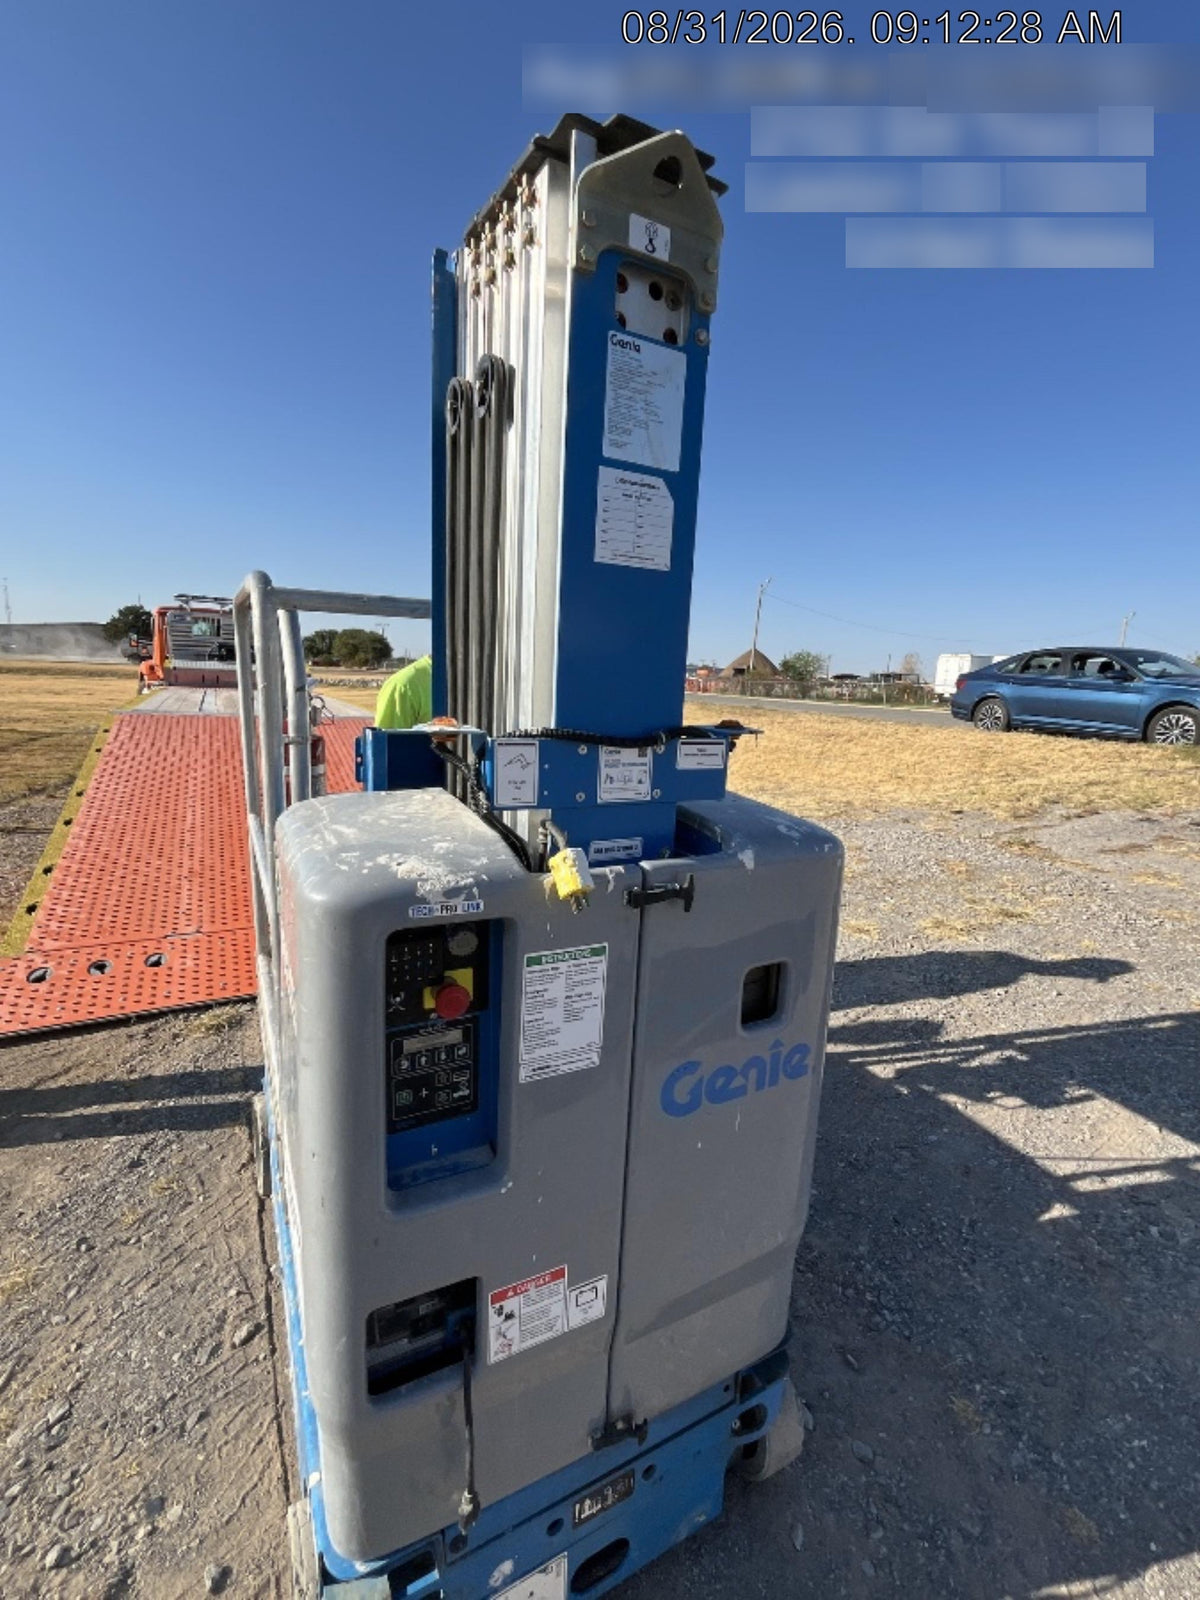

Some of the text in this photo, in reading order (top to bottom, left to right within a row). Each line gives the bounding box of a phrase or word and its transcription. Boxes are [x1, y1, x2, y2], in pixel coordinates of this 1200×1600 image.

[440, 904, 458, 915] PRO
[461, 902, 481, 912] LINK
[660, 1038, 812, 1118] Genie
